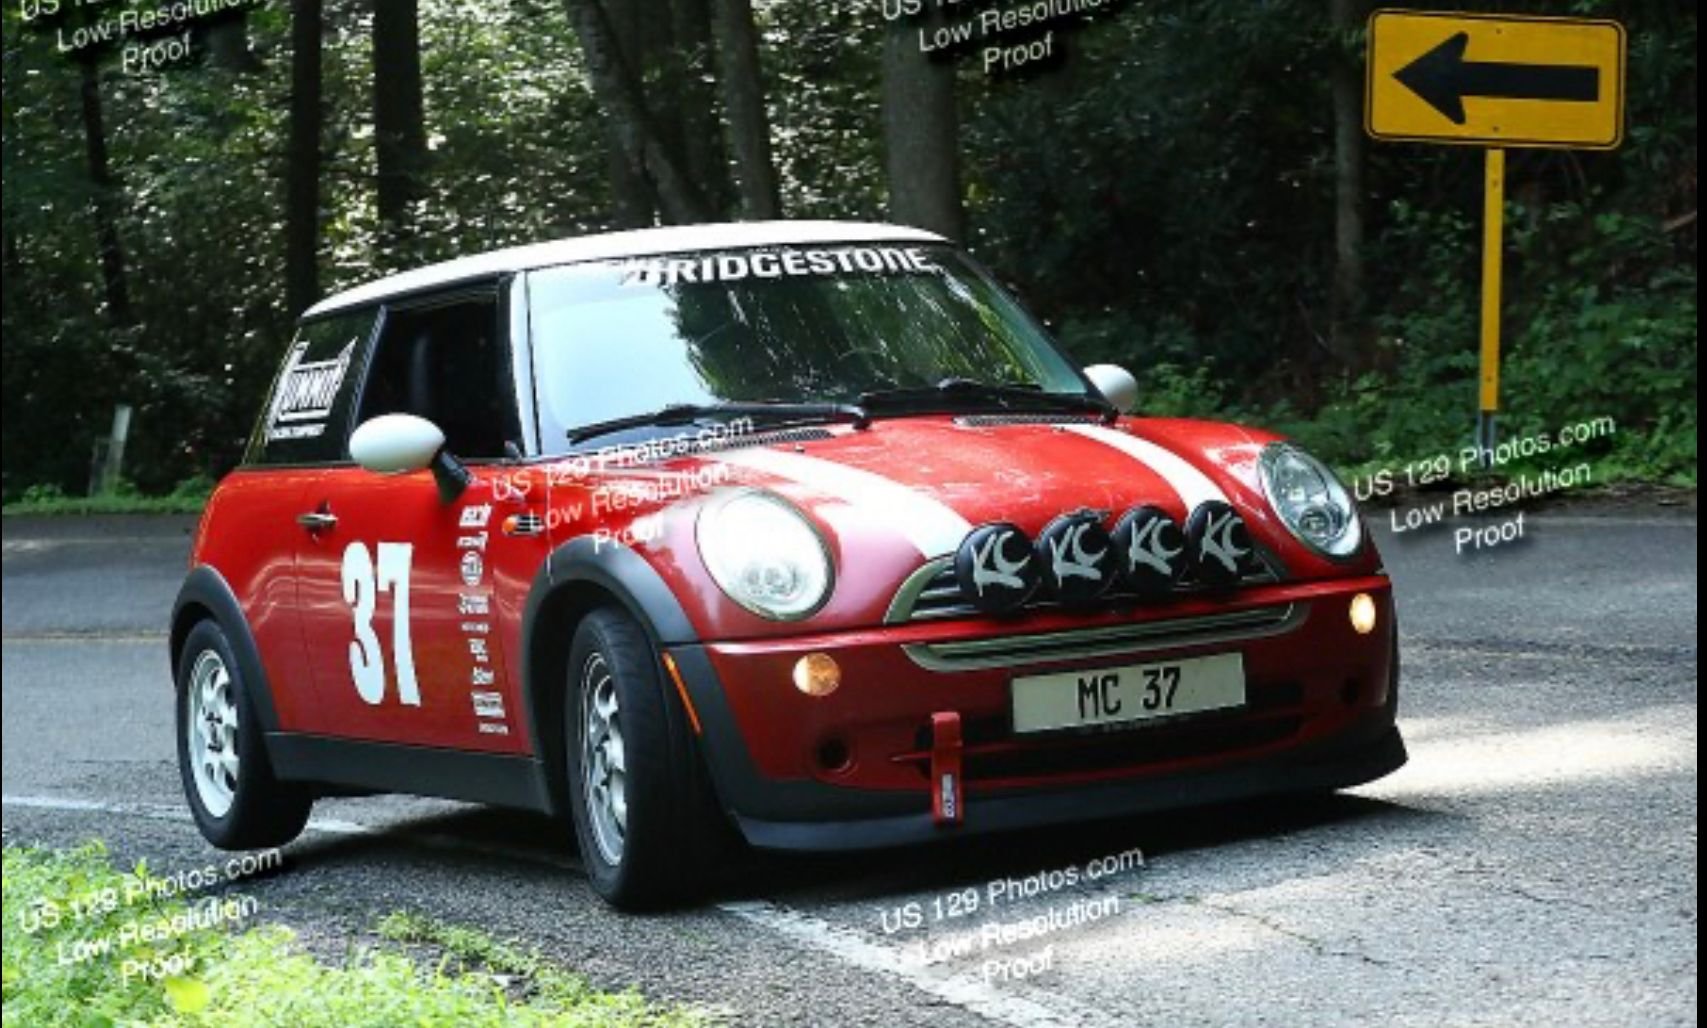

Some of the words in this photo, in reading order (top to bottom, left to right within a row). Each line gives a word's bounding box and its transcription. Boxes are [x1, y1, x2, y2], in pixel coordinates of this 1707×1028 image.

[971, 530, 1031, 597] KC
[1050, 522, 1108, 589] KC
[1128, 516, 1183, 575] KC
[1199, 510, 1250, 574] KC
[340, 540, 422, 707] 37
[1078, 674, 1121, 719] MC
[1142, 666, 1181, 710] 37
